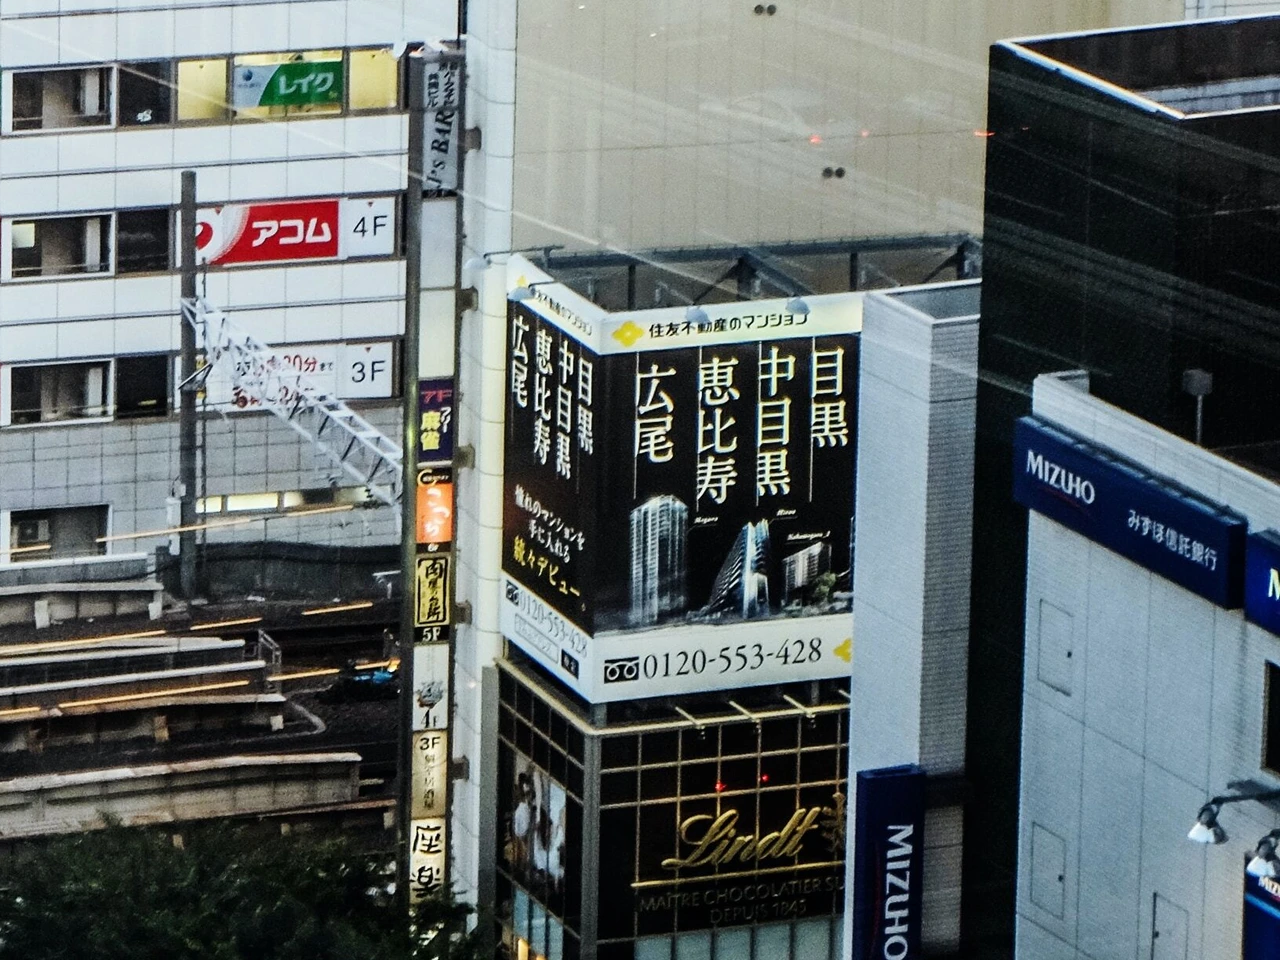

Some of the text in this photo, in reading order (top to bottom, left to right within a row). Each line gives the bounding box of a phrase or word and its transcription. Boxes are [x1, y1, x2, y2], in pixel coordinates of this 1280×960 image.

[278, 72, 335, 96] レイク
[251, 217, 333, 248] アコム
[352, 215, 388, 239] 4F
[649, 313, 809, 339] 住友不動産のマンション
[350, 359, 386, 383] 3F
[513, 315, 530, 407] 広尾
[534, 328, 553, 465] 恵比寿
[557, 340, 574, 480] 中目黒
[578, 357, 593, 455] 目黒
[635, 363, 677, 464] 広尾
[756, 346, 796, 498] 中目黒
[811, 346, 849, 448] 目黒
[696, 356, 741, 505] 恵比寿
[1026, 449, 1096, 505] MIZUHO
[528, 519, 571, 563] 手に入れる
[1127, 509, 1218, 572] みずほ信託銀行
[422, 626, 442, 641] 5F
[519, 589, 590, 657] 0120-553-428
[643, 637, 822, 680] 0120-553-428
[419, 737, 440, 750] 3F
[661, 809, 821, 869] Lindt
[703, 877, 820, 906] CHOCOLATIER
[710, 904, 768, 924] DEPUIS
[883, 824, 914, 959] MIZUHO
